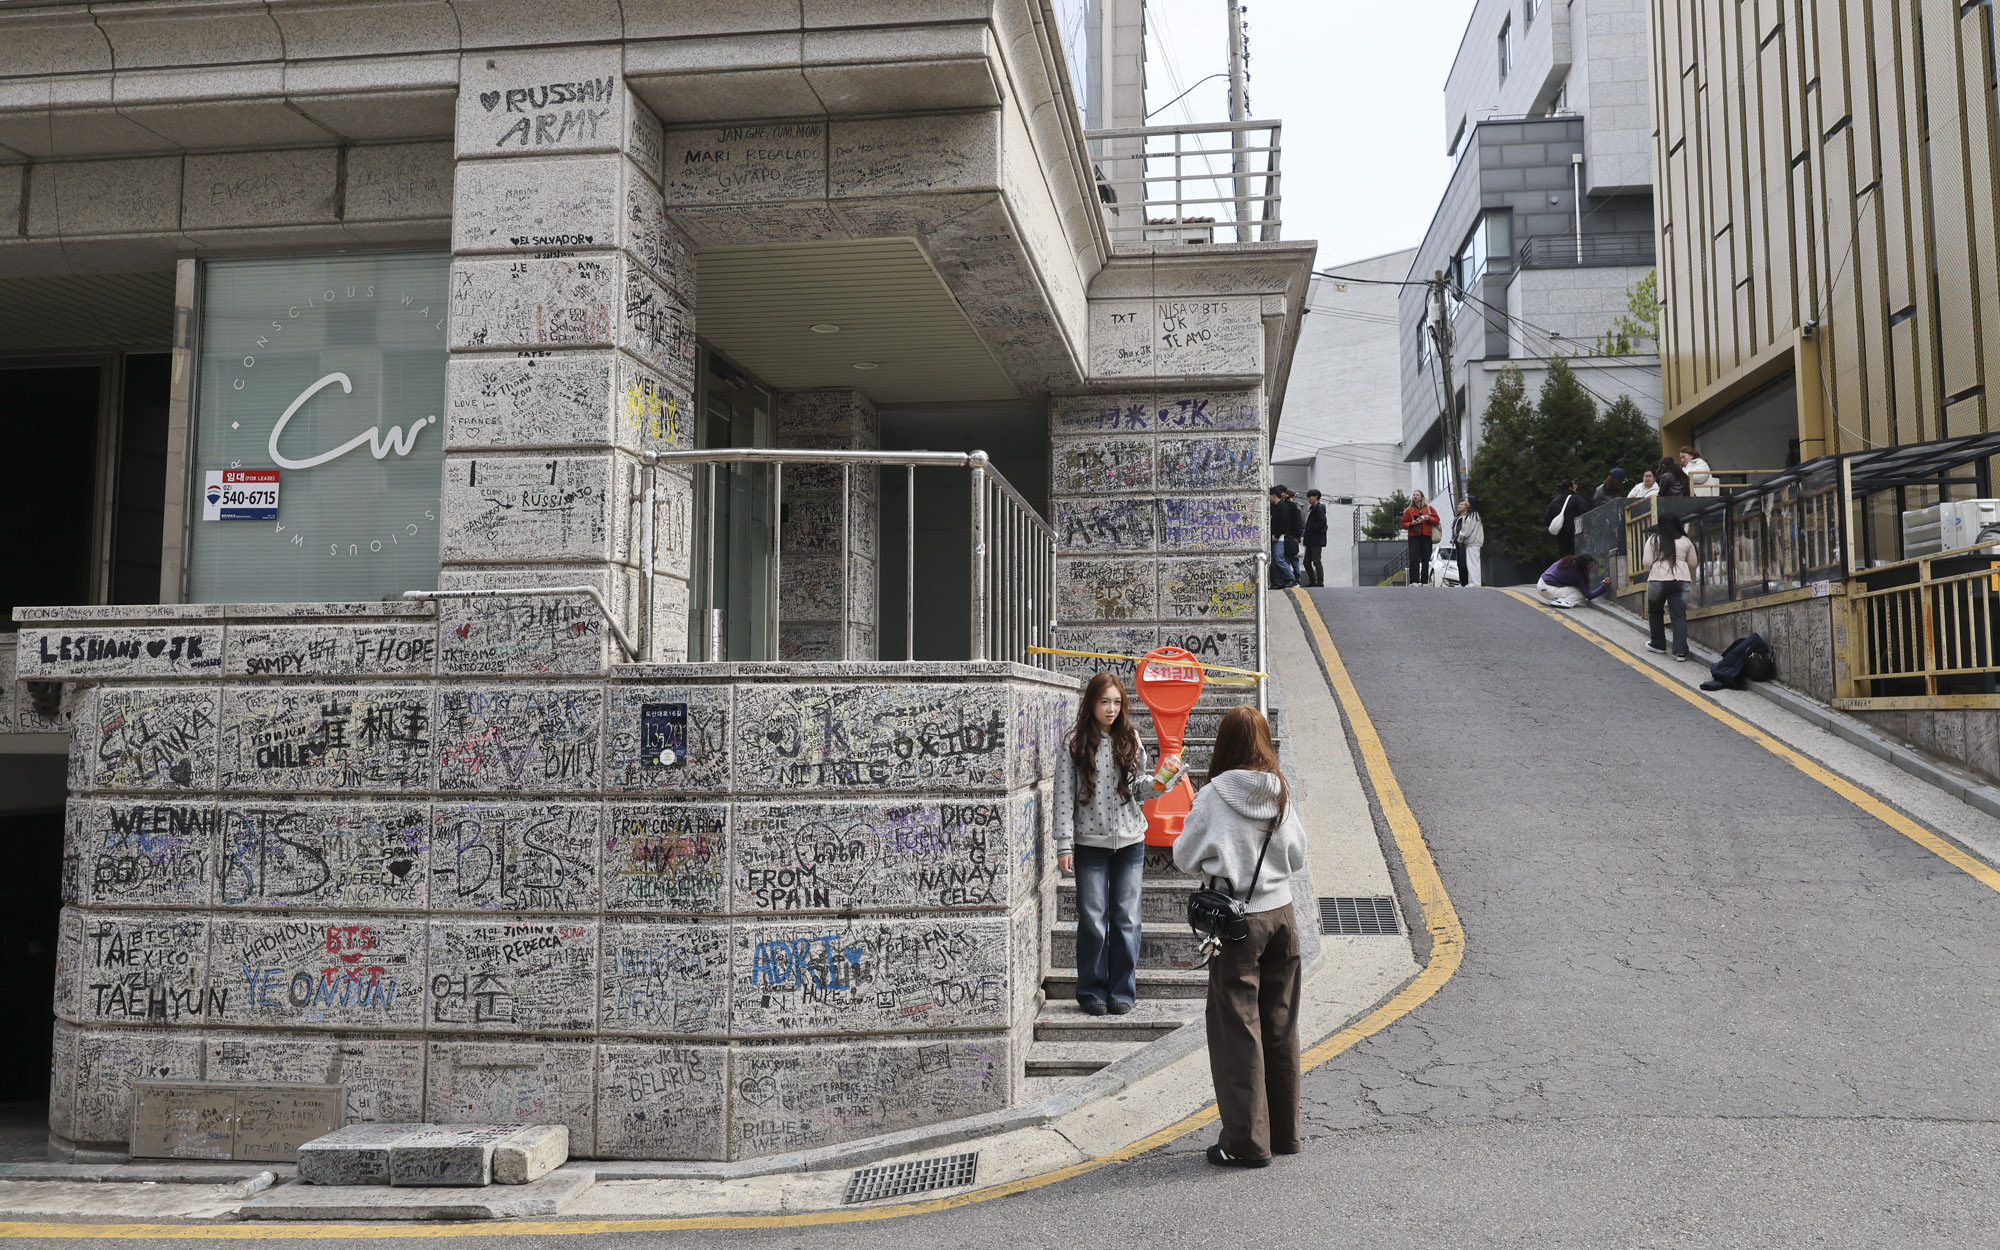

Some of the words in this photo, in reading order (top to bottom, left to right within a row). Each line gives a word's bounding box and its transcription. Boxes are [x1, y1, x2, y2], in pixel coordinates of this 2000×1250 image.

[496, 108, 610, 147] ARMY
[684, 150, 730, 164] MARI
[718, 168, 781, 187] GWAPO
[520, 236, 530, 246] EL
[533, 234, 584, 246] SALVADOR
[1111, 312, 1137, 324] TXT
[1203, 302, 1228, 314] BTS
[1163, 315, 1187, 332] JK
[234, 285, 375, 390] CONSCIOUS
[1162, 333, 1182, 349] TE
[1186, 329, 1211, 347] AMO
[455, 400, 477, 408] LOVE
[1173, 399, 1213, 426] JK
[227, 472, 245, 482] 임대
[222, 490, 276, 505] 540-6715
[1168, 526, 1261, 542] MELBOURNE
[1095, 586, 1122, 599] BTS
[1095, 606, 1135, 618] ARMY
[1171, 604, 1193, 617] TXT
[40, 636, 142, 663] LESBIANS
[169, 636, 203, 660] JK
[356, 636, 435, 664] J-HOPE
[246, 654, 305, 675] SAMPY
[616, 667, 645, 676] YOU'RE
[652, 667, 666, 675] MY
[666, 666, 713, 675] STRENGTH
[256, 743, 310, 768] CHILE
[339, 768, 361, 787] JIN
[652, 819, 693, 835] COSTA
[941, 804, 1001, 829] DIOSA
[222, 809, 331, 904] BTS
[456, 817, 565, 899] BTS
[749, 864, 820, 891] FROM
[918, 863, 1000, 892] NANAY
[504, 888, 578, 911] SANDRA
[755, 888, 830, 911] SPAIN
[940, 886, 998, 907] CELSA
[132, 929, 170, 946] BTS
[326, 925, 374, 954] BTS
[504, 926, 544, 937] JIMIN
[243, 922, 326, 964] HADHOUM
[503, 936, 562, 965] REBECCA
[106, 951, 189, 967] MEXICO
[752, 935, 851, 991] ADRI
[243, 963, 395, 1009] YEONJUN
[321, 966, 385, 987] TXT
[89, 983, 228, 1018] TAEHYUN
[629, 1063, 707, 1102] BELARUS
[743, 1120, 797, 1139] BILLIE
